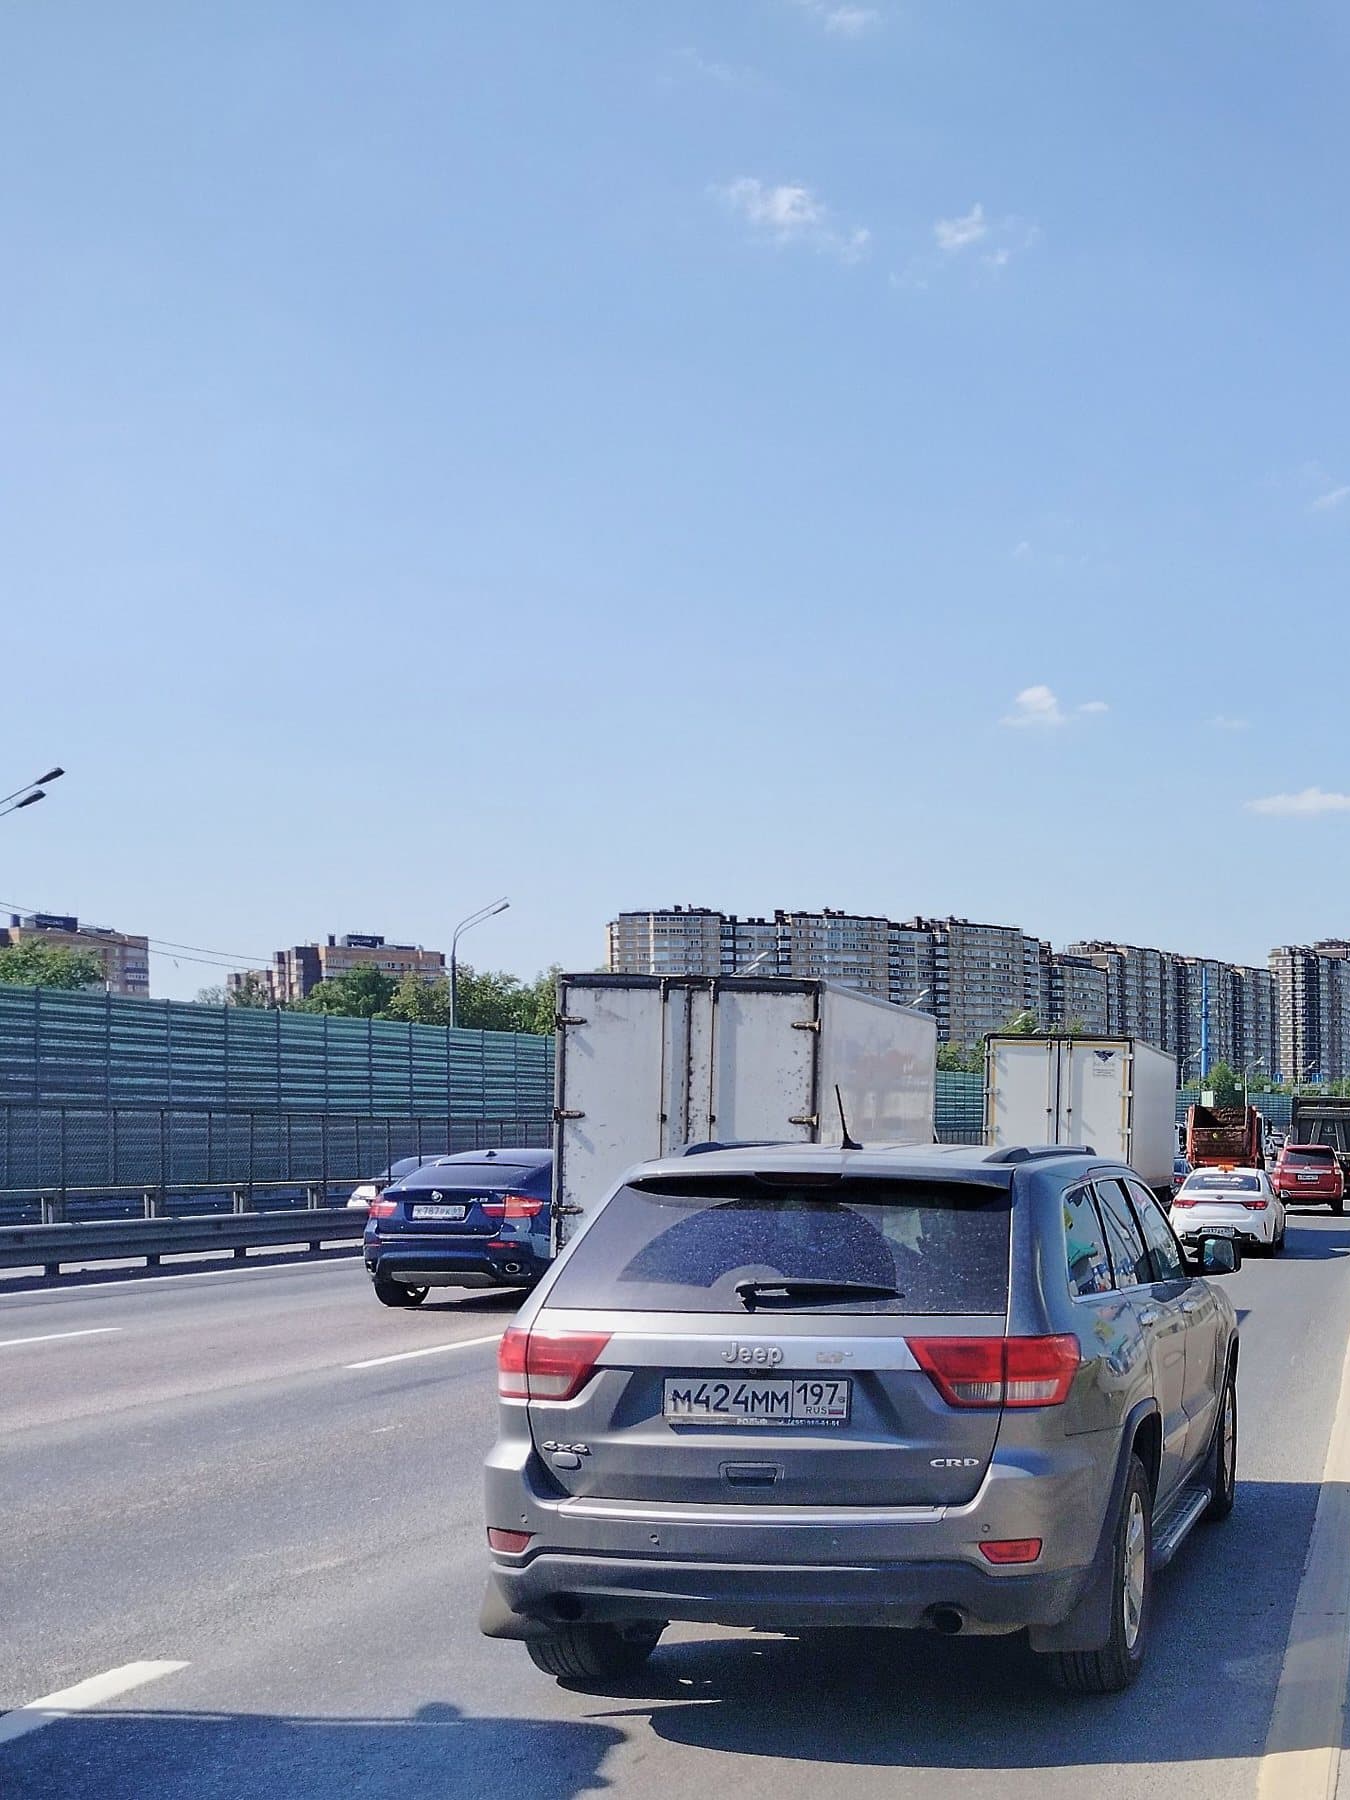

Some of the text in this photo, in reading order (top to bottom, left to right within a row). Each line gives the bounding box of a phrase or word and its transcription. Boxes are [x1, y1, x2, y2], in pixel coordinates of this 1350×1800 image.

[721, 1342, 784, 1367] Jeep
[796, 1382, 839, 1406] 197
[805, 1406, 828, 1416] RUS
[929, 1457, 980, 1468] CRD
